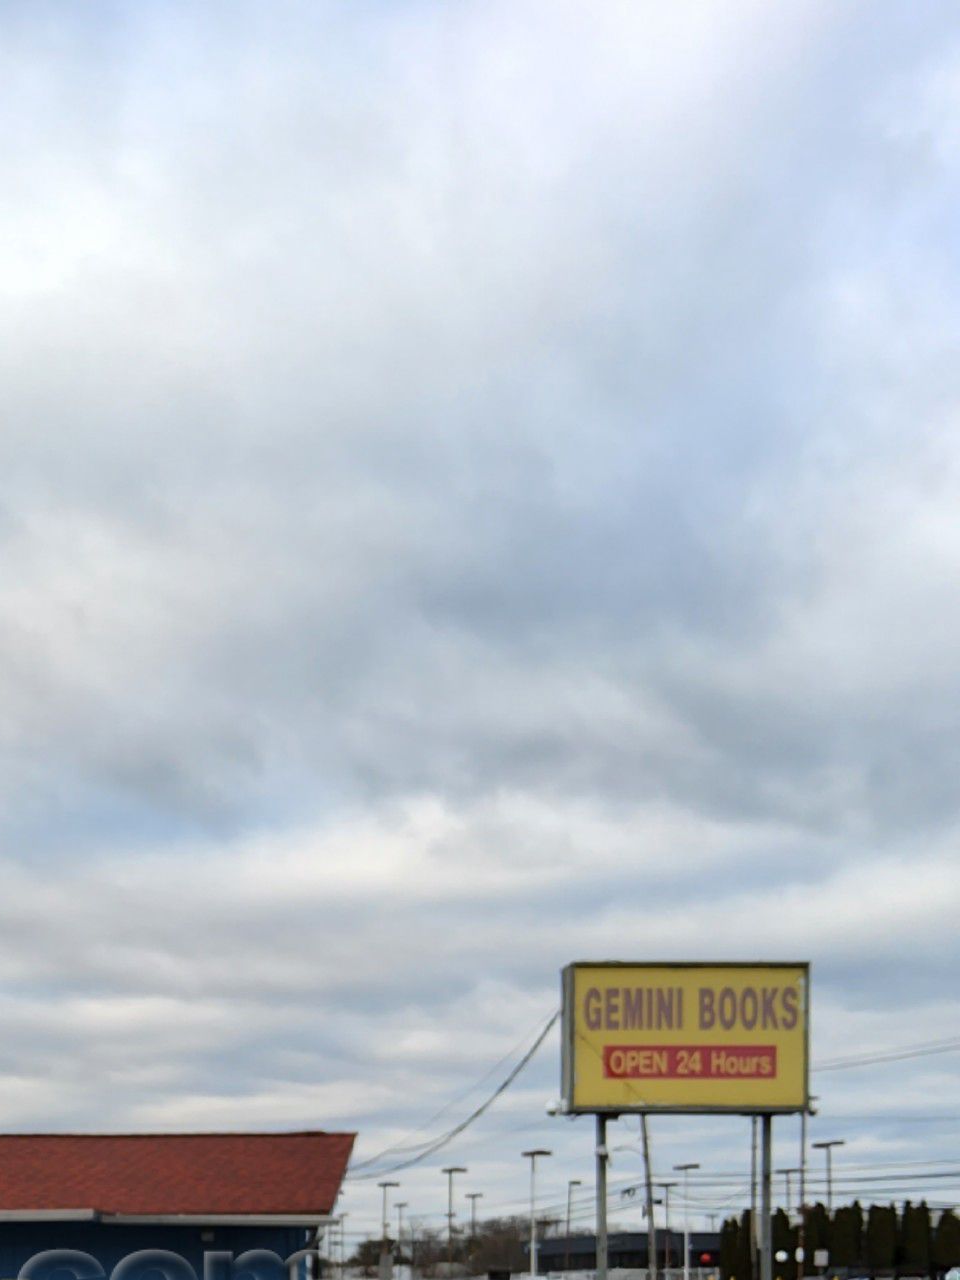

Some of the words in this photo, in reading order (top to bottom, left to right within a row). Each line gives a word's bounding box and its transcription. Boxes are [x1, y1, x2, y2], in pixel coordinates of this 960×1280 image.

[584, 987, 683, 1030] GEMINI
[698, 986, 799, 1030] BOOKS
[609, 1051, 668, 1074] OPEN
[676, 1050, 702, 1074] 24
[711, 1051, 772, 1075] Hours
